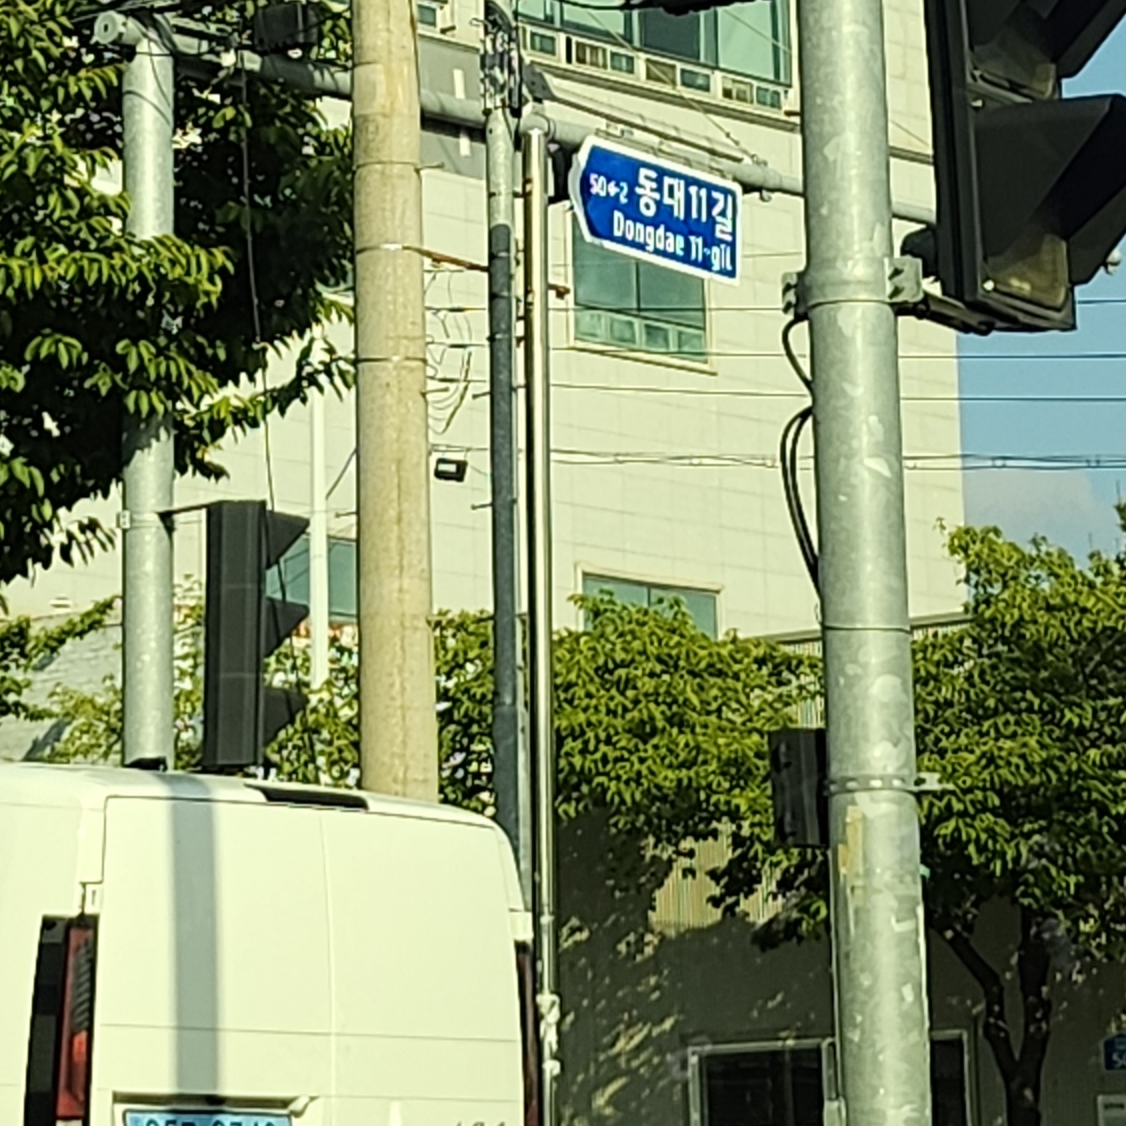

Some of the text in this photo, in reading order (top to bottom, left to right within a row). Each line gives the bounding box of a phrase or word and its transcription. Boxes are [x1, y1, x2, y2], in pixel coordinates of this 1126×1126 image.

[635, 167, 733, 241] 동대11길
[613, 210, 733, 272] Dongdae 11-gil
